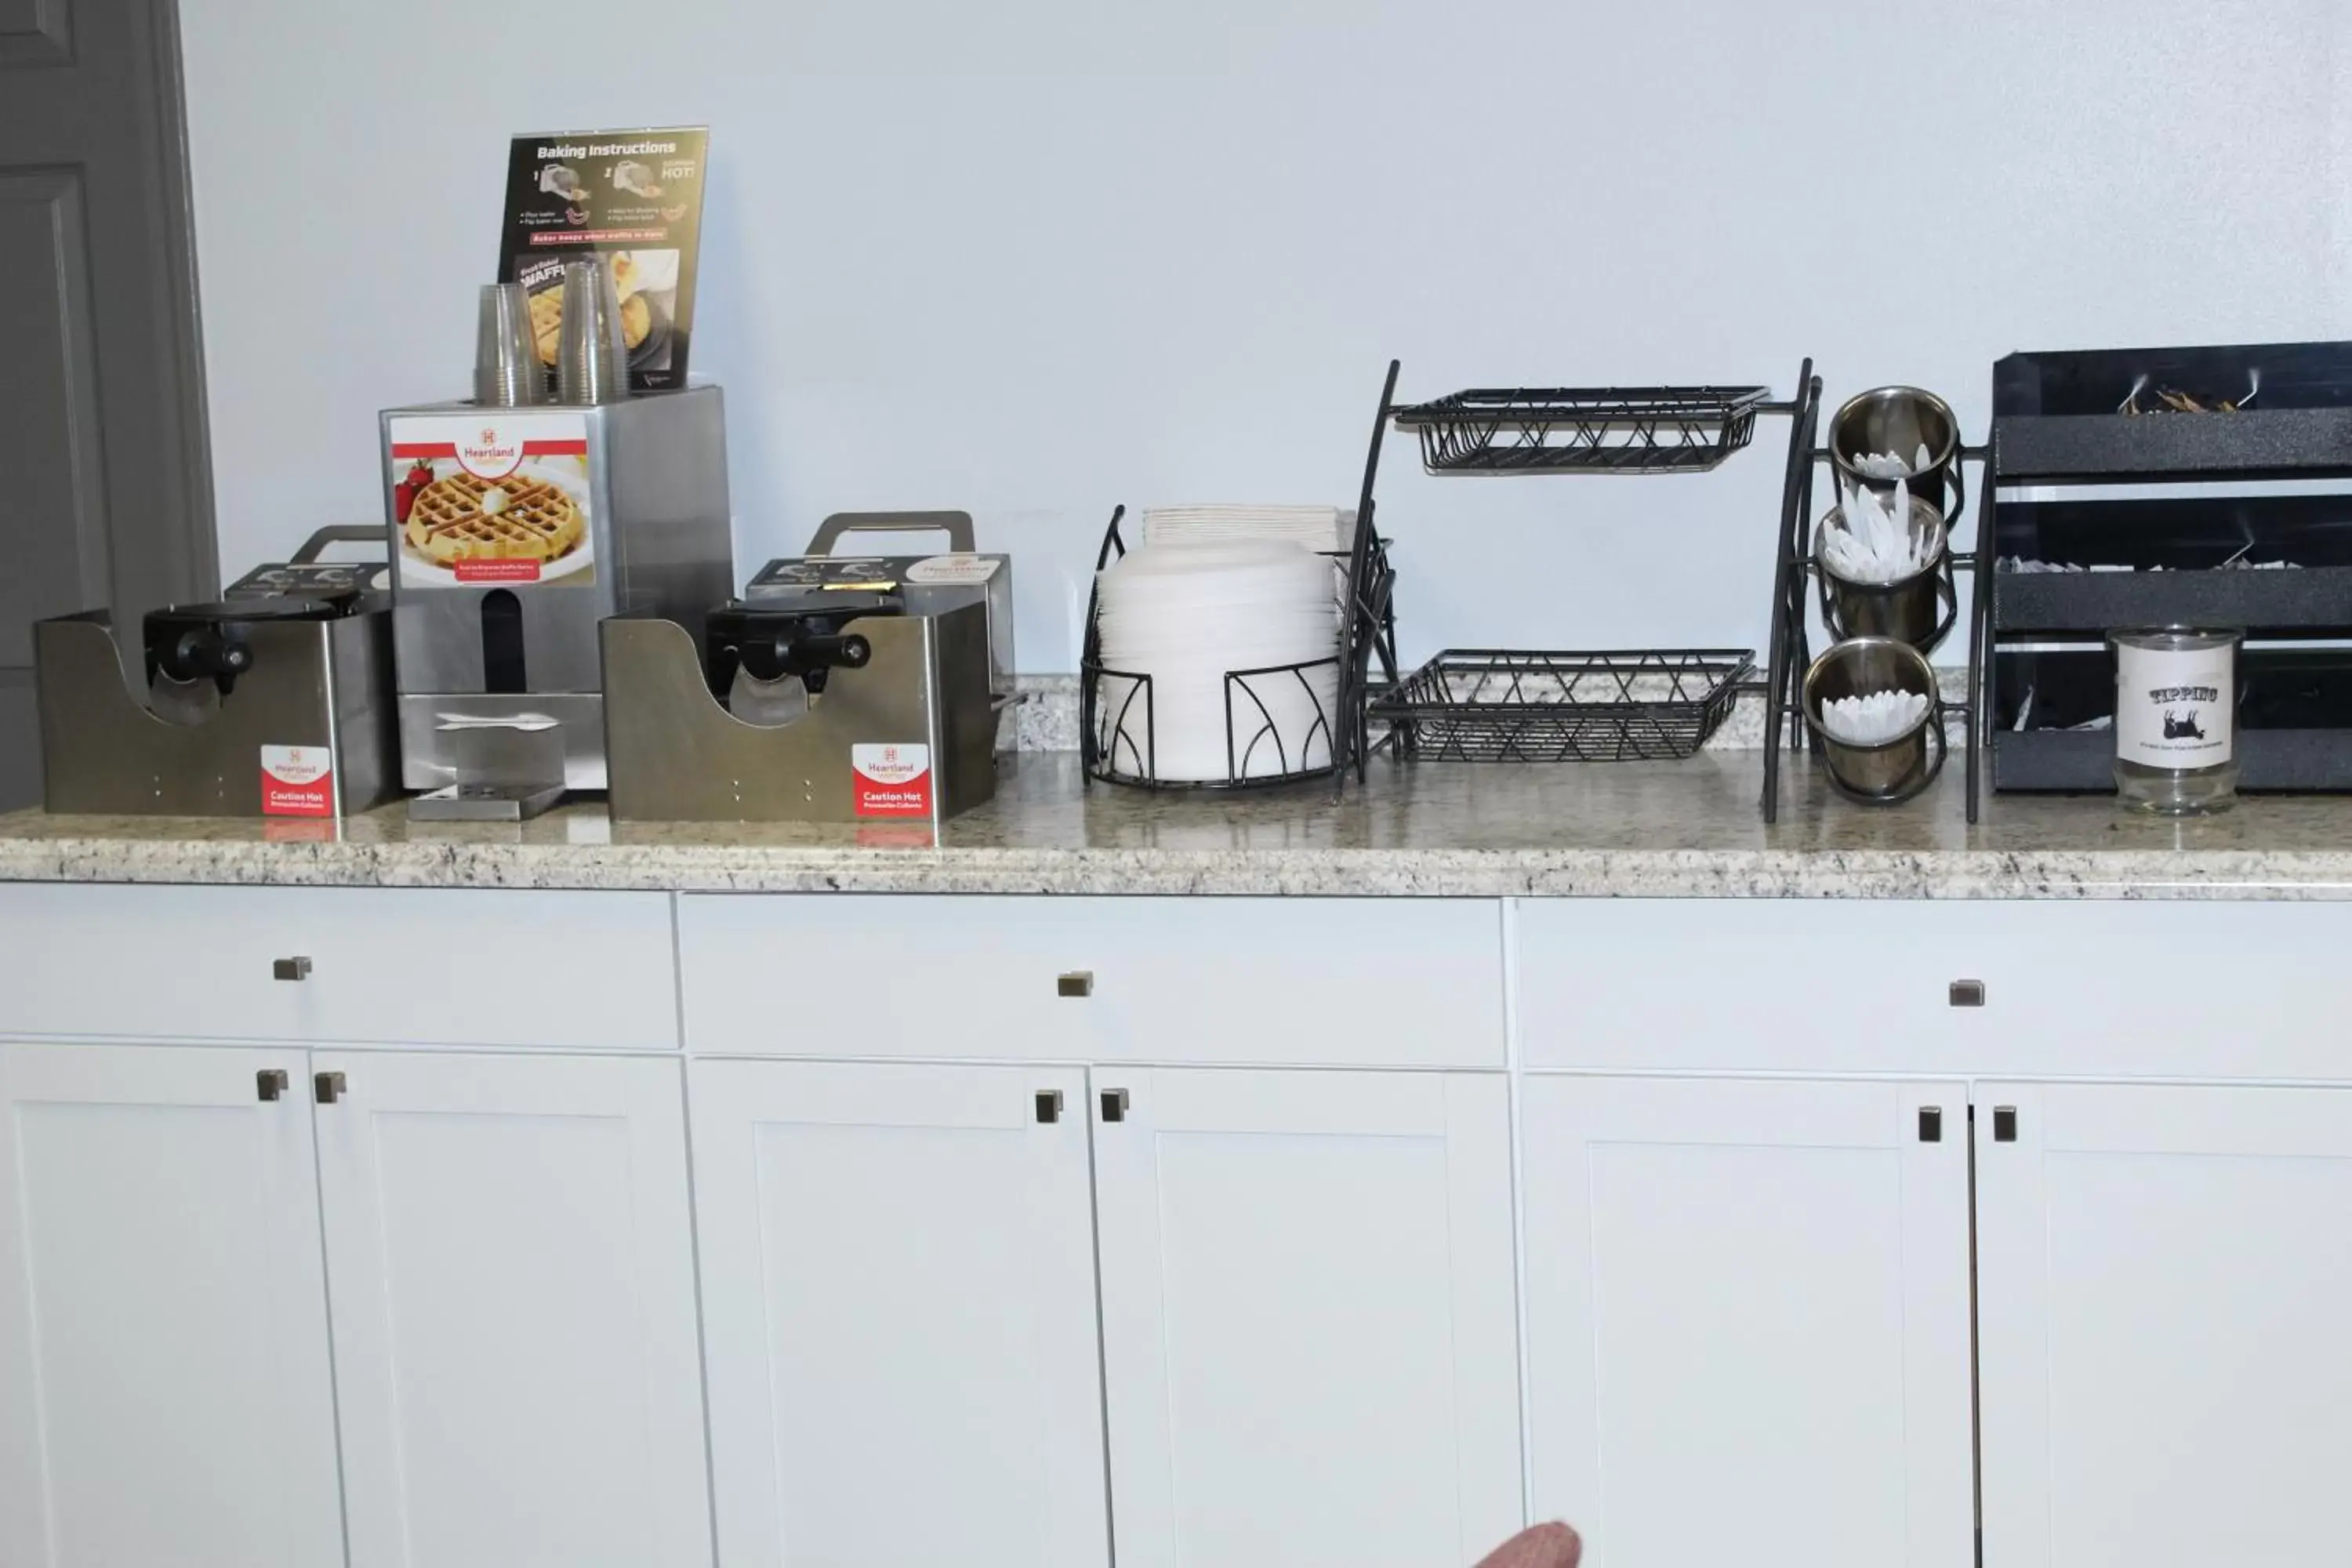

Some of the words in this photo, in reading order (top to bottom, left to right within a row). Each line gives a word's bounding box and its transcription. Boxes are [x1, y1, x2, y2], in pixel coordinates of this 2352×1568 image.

[537, 145, 586, 159] Baking
[589, 141, 677, 156] Instructions
[464, 446, 514, 458] Heartland
[2148, 686, 2219, 704] TIPPING
[868, 762, 914, 772] Heartland
[270, 790, 306, 801] Caution
[307, 793, 324, 803] Hot
[863, 791, 902, 801] Caution
[903, 792, 923, 801] Hot
